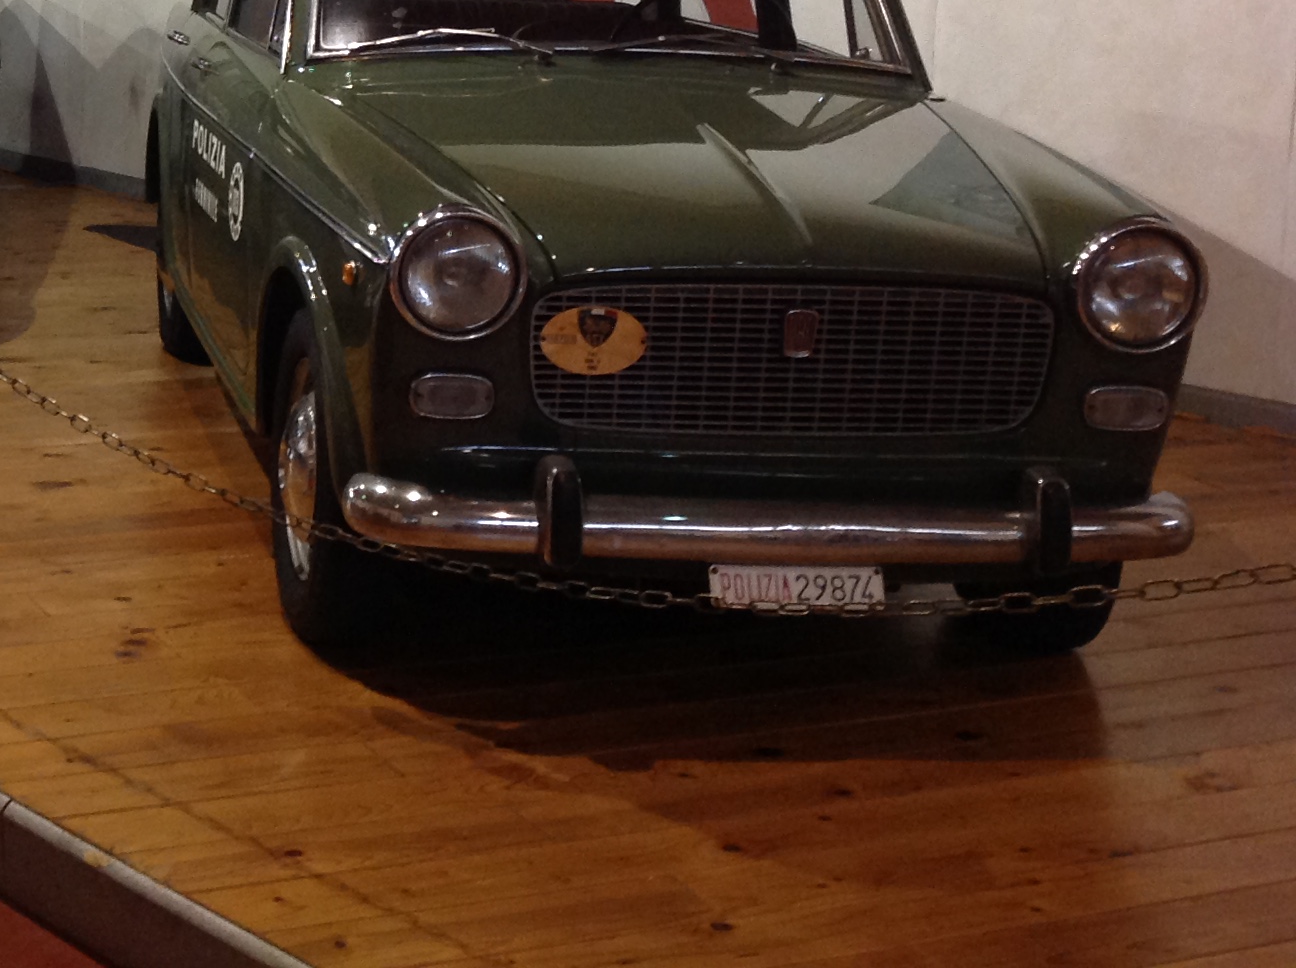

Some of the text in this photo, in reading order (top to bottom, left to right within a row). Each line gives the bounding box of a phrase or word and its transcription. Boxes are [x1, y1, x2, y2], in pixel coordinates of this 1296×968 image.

[192, 118, 226, 179] POLIZIA
[720, 572, 876, 604] POLIZIA 29874
